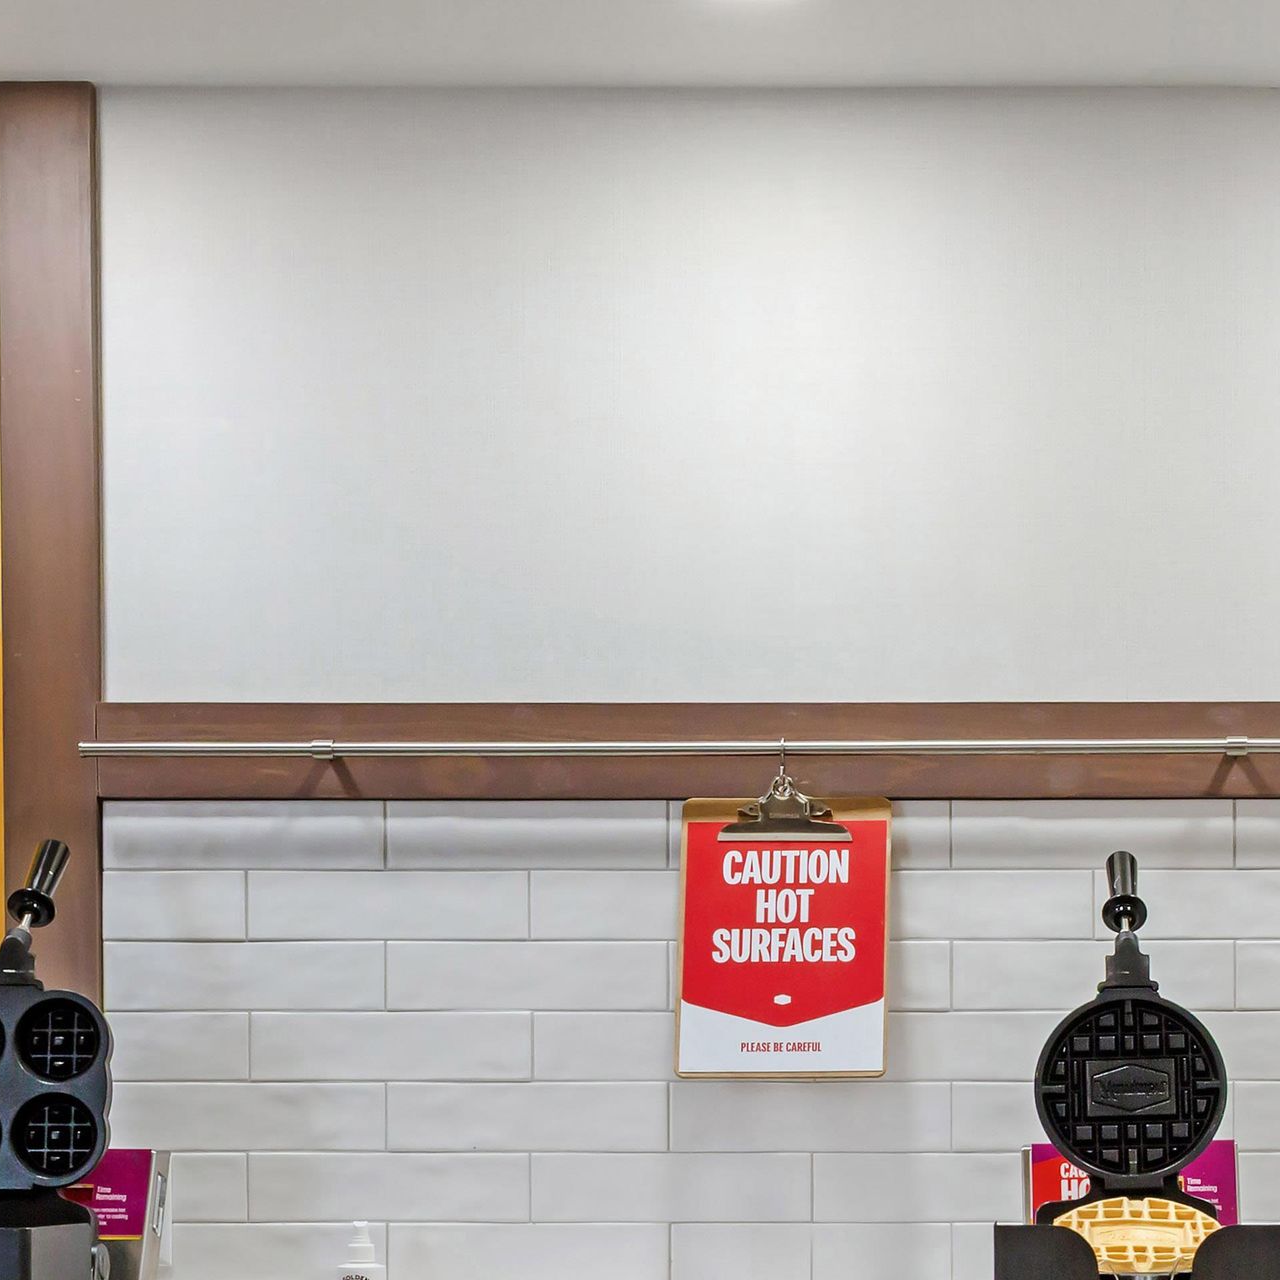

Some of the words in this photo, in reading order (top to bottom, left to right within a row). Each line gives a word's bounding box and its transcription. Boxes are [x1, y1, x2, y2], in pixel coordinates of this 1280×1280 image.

[722, 849, 850, 885] CAUTION
[755, 888, 815, 924] HOT
[711, 926, 857, 964] SURFACES
[740, 1041, 771, 1053] PLEASE
[773, 1041, 784, 1053] BE
[785, 1041, 823, 1052] CAREFUL
[1060, 1178, 1091, 1201] HO
